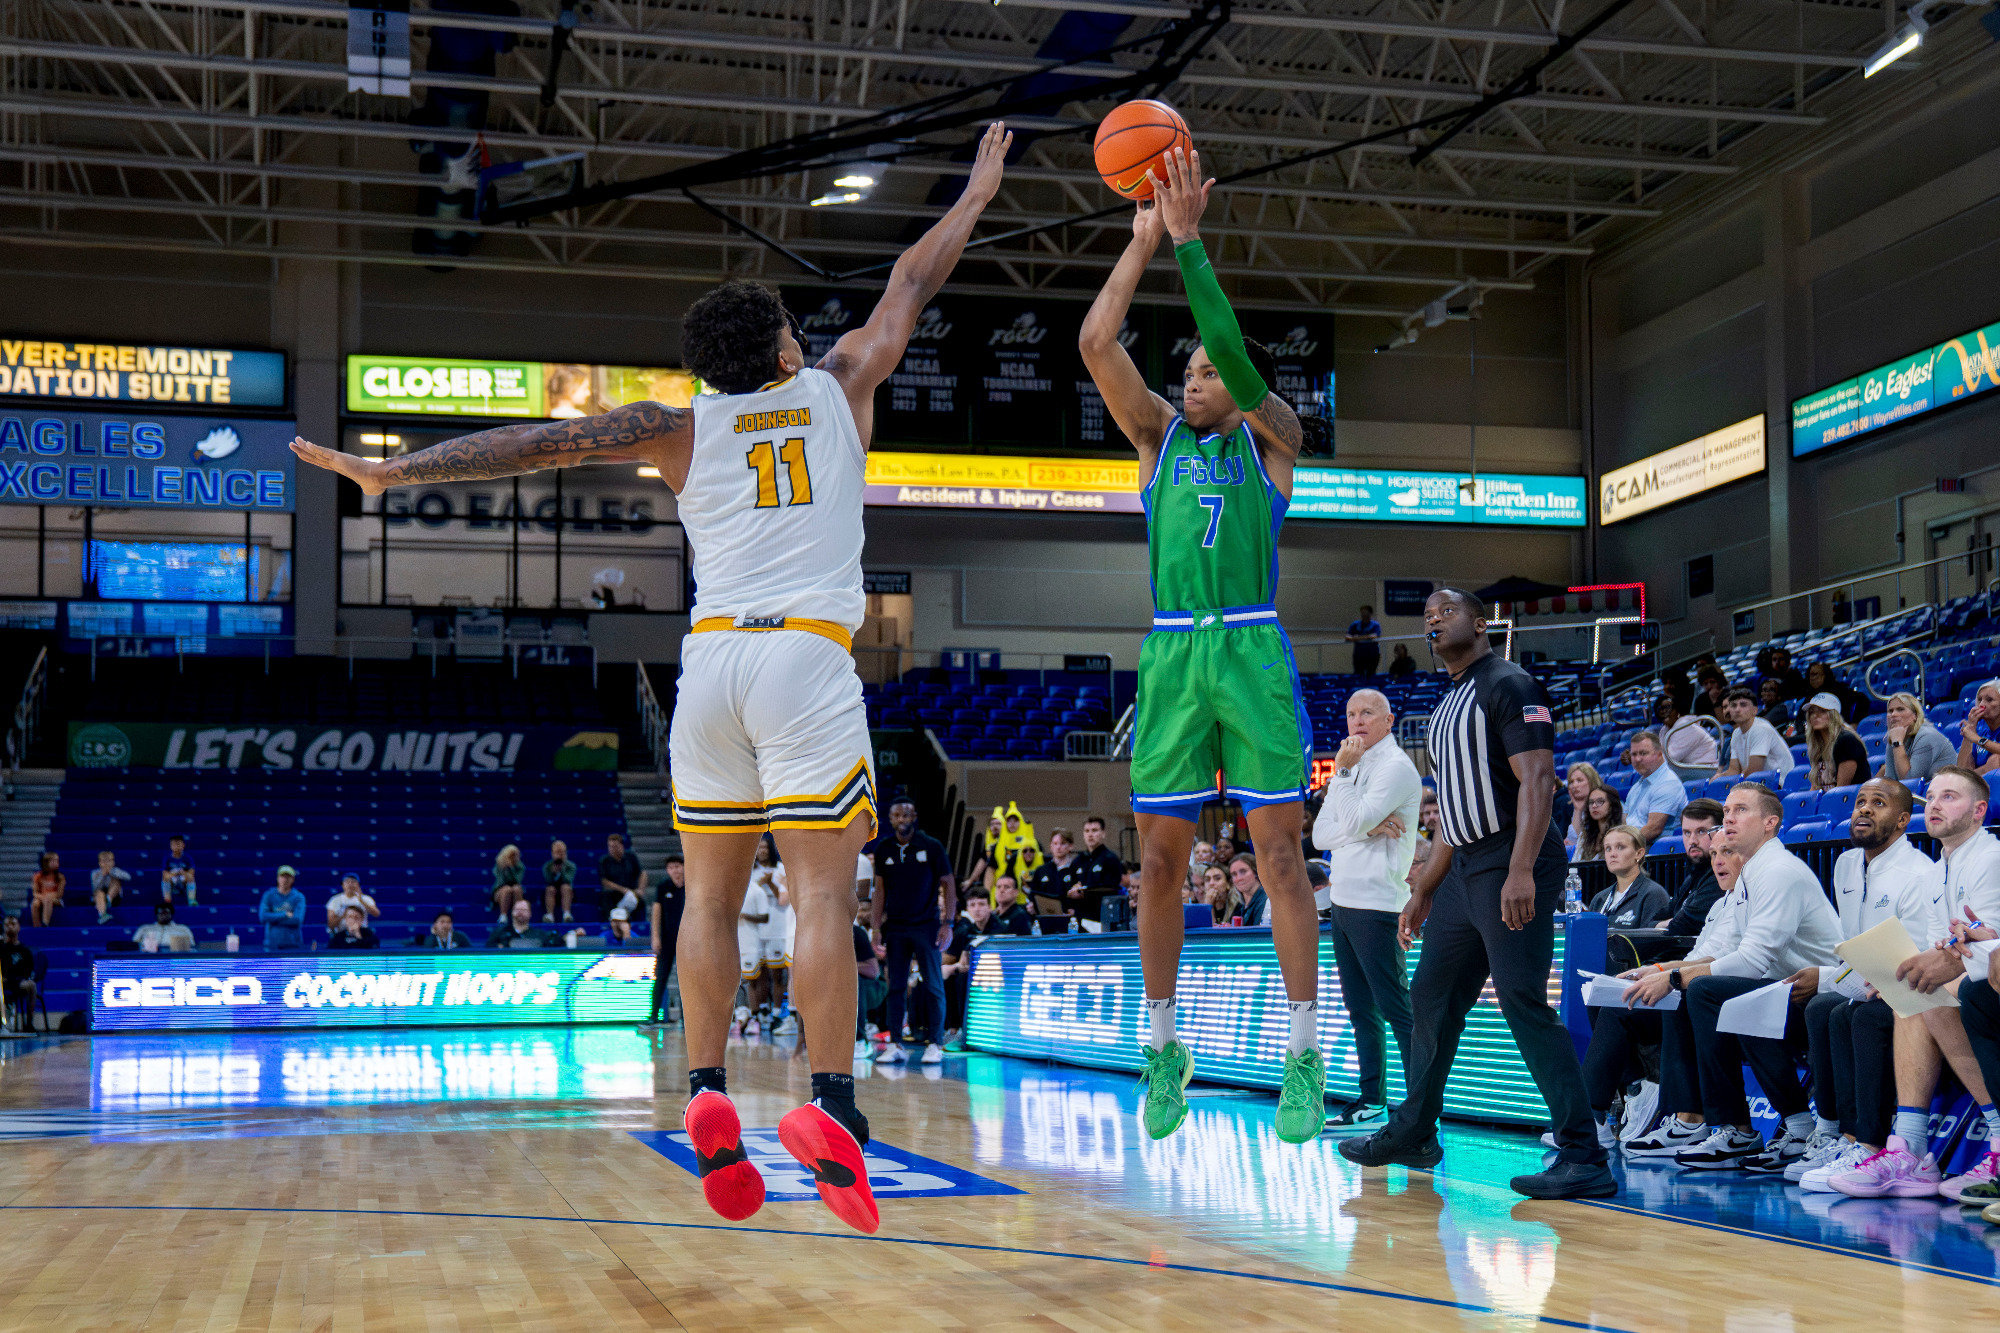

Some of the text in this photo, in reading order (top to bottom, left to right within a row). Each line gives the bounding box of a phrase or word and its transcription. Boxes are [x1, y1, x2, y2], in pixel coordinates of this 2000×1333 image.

[0, 339, 233, 377] YER-TREMONT
[128, 373, 232, 404] SUITE
[362, 366, 494, 398] CLOSER
[1864, 353, 1936, 405] Go Eagles!
[1793, 417, 1807, 430] From
[1807, 413, 1819, 428] your
[1831, 407, 1838, 417] on
[1838, 402, 1847, 414] the
[1800, 403, 1809, 416] the
[1809, 397, 1829, 412] winners
[1829, 394, 1836, 404] on
[1836, 389, 1846, 402] the
[734, 407, 811, 434] JOHNSON
[1660, 430, 1761, 476] COMMERCIAL AIR MANAGEMENT
[1709, 447, 1761, 472] Representative
[0, 460, 286, 507] XCELLENCE
[746, 437, 813, 509] 11
[880, 464, 900, 478] The
[902, 464, 938, 479] North
[940, 464, 964, 479] Law
[1037, 468, 1137, 485] 239-337-1191
[1172, 455, 1246, 487] FGCU
[1341, 473, 1367, 485] When
[1367, 475, 1384, 486] You
[1388, 477, 1457, 490] HOMEWOOD
[897, 486, 1106, 509] Accident & Injury Cases
[1336, 487, 1357, 499] With
[1421, 489, 1458, 501] SUITES
[1485, 491, 1578, 509] Garden Inn
[1486, 480, 1524, 493] Hilton
[1616, 468, 1660, 505] CAM
[379, 489, 656, 537] GO EAGLES
[1198, 495, 1225, 548] 7
[1485, 507, 1503, 517] Fort
[1504, 508, 1527, 519] Myers
[164, 728, 524, 772] LET'S GO NUTS!
[102, 970, 560, 1009] GEICO COCONUT HOOPS
[1019, 964, 1124, 1044] GEICO
